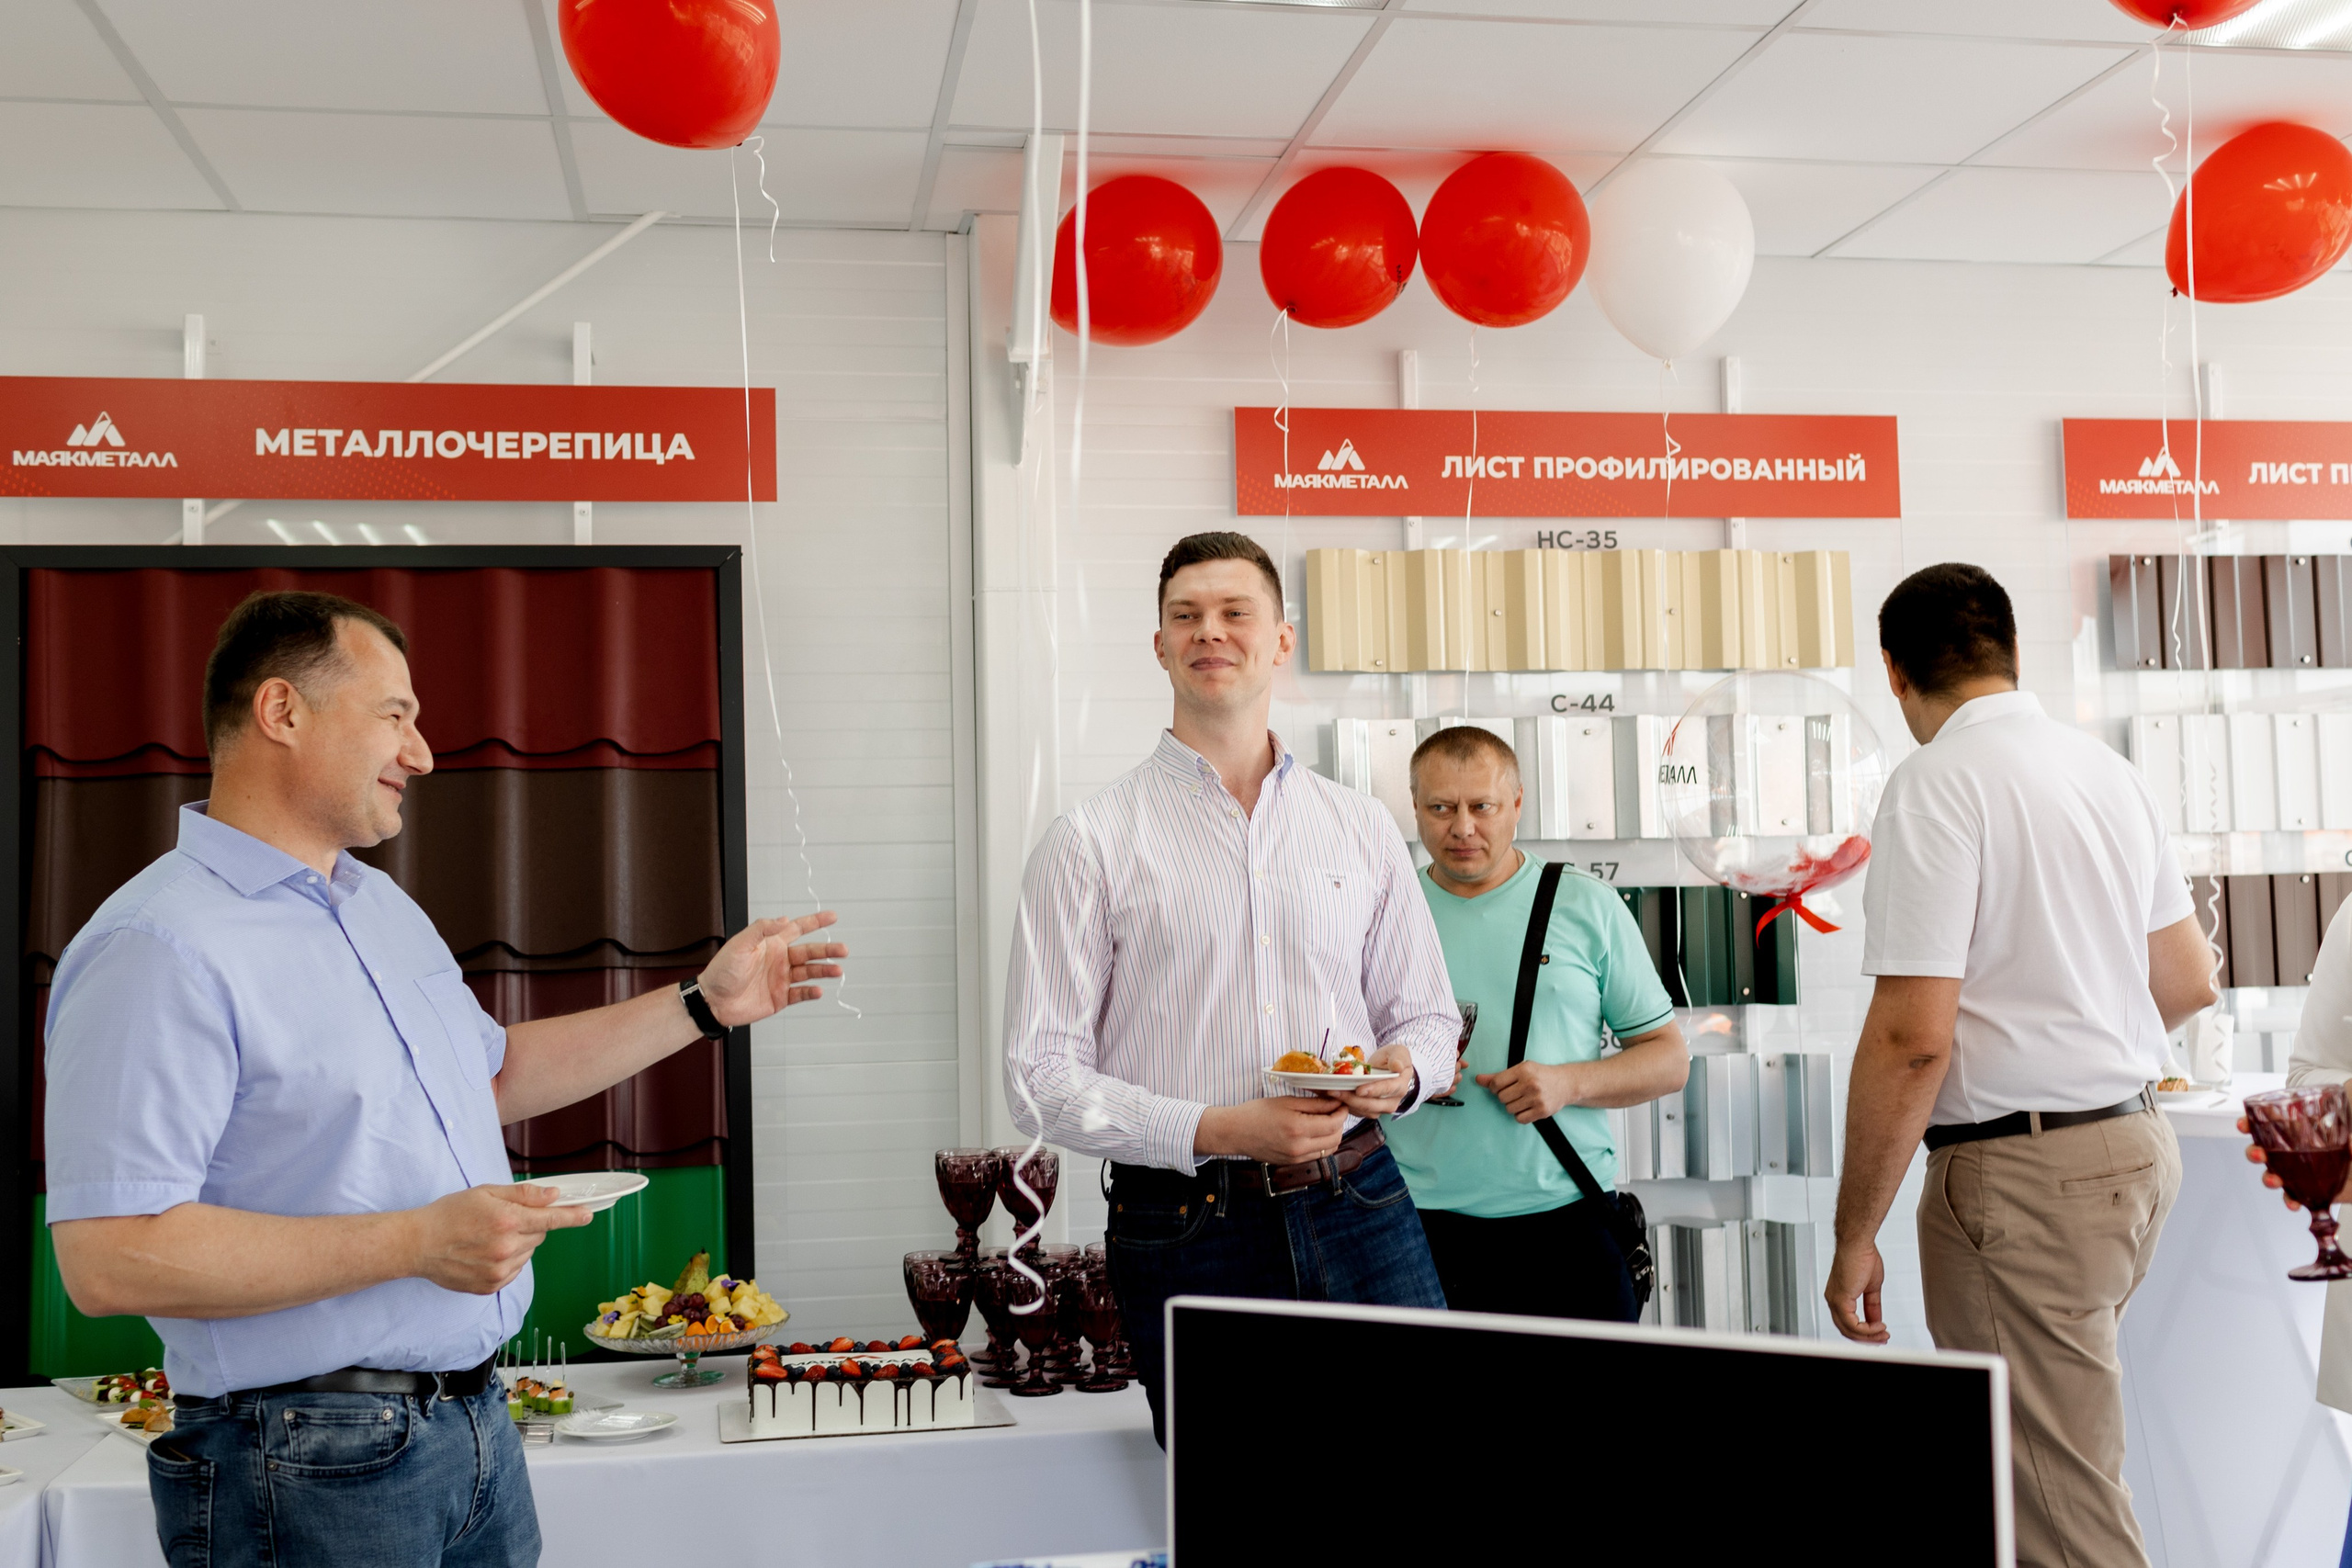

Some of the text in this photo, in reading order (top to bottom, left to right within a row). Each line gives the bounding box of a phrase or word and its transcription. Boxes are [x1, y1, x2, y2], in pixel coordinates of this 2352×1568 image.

[255, 427, 695, 466] МЕТАЛЛОЧЕРЕПИЦА
[12, 450, 178, 468] МАЯКМЕТАЛЛ
[1442, 453, 1867, 481] ЛИСТ ПРОФИЛИРОВАННЫЙ
[1273, 473, 1409, 490] МАЯКМЕТАЛЛ
[2248, 462, 2352, 485] ЛИСТ П
[1537, 530, 1618, 550] НС-35
[1550, 694, 1615, 714] С-44
